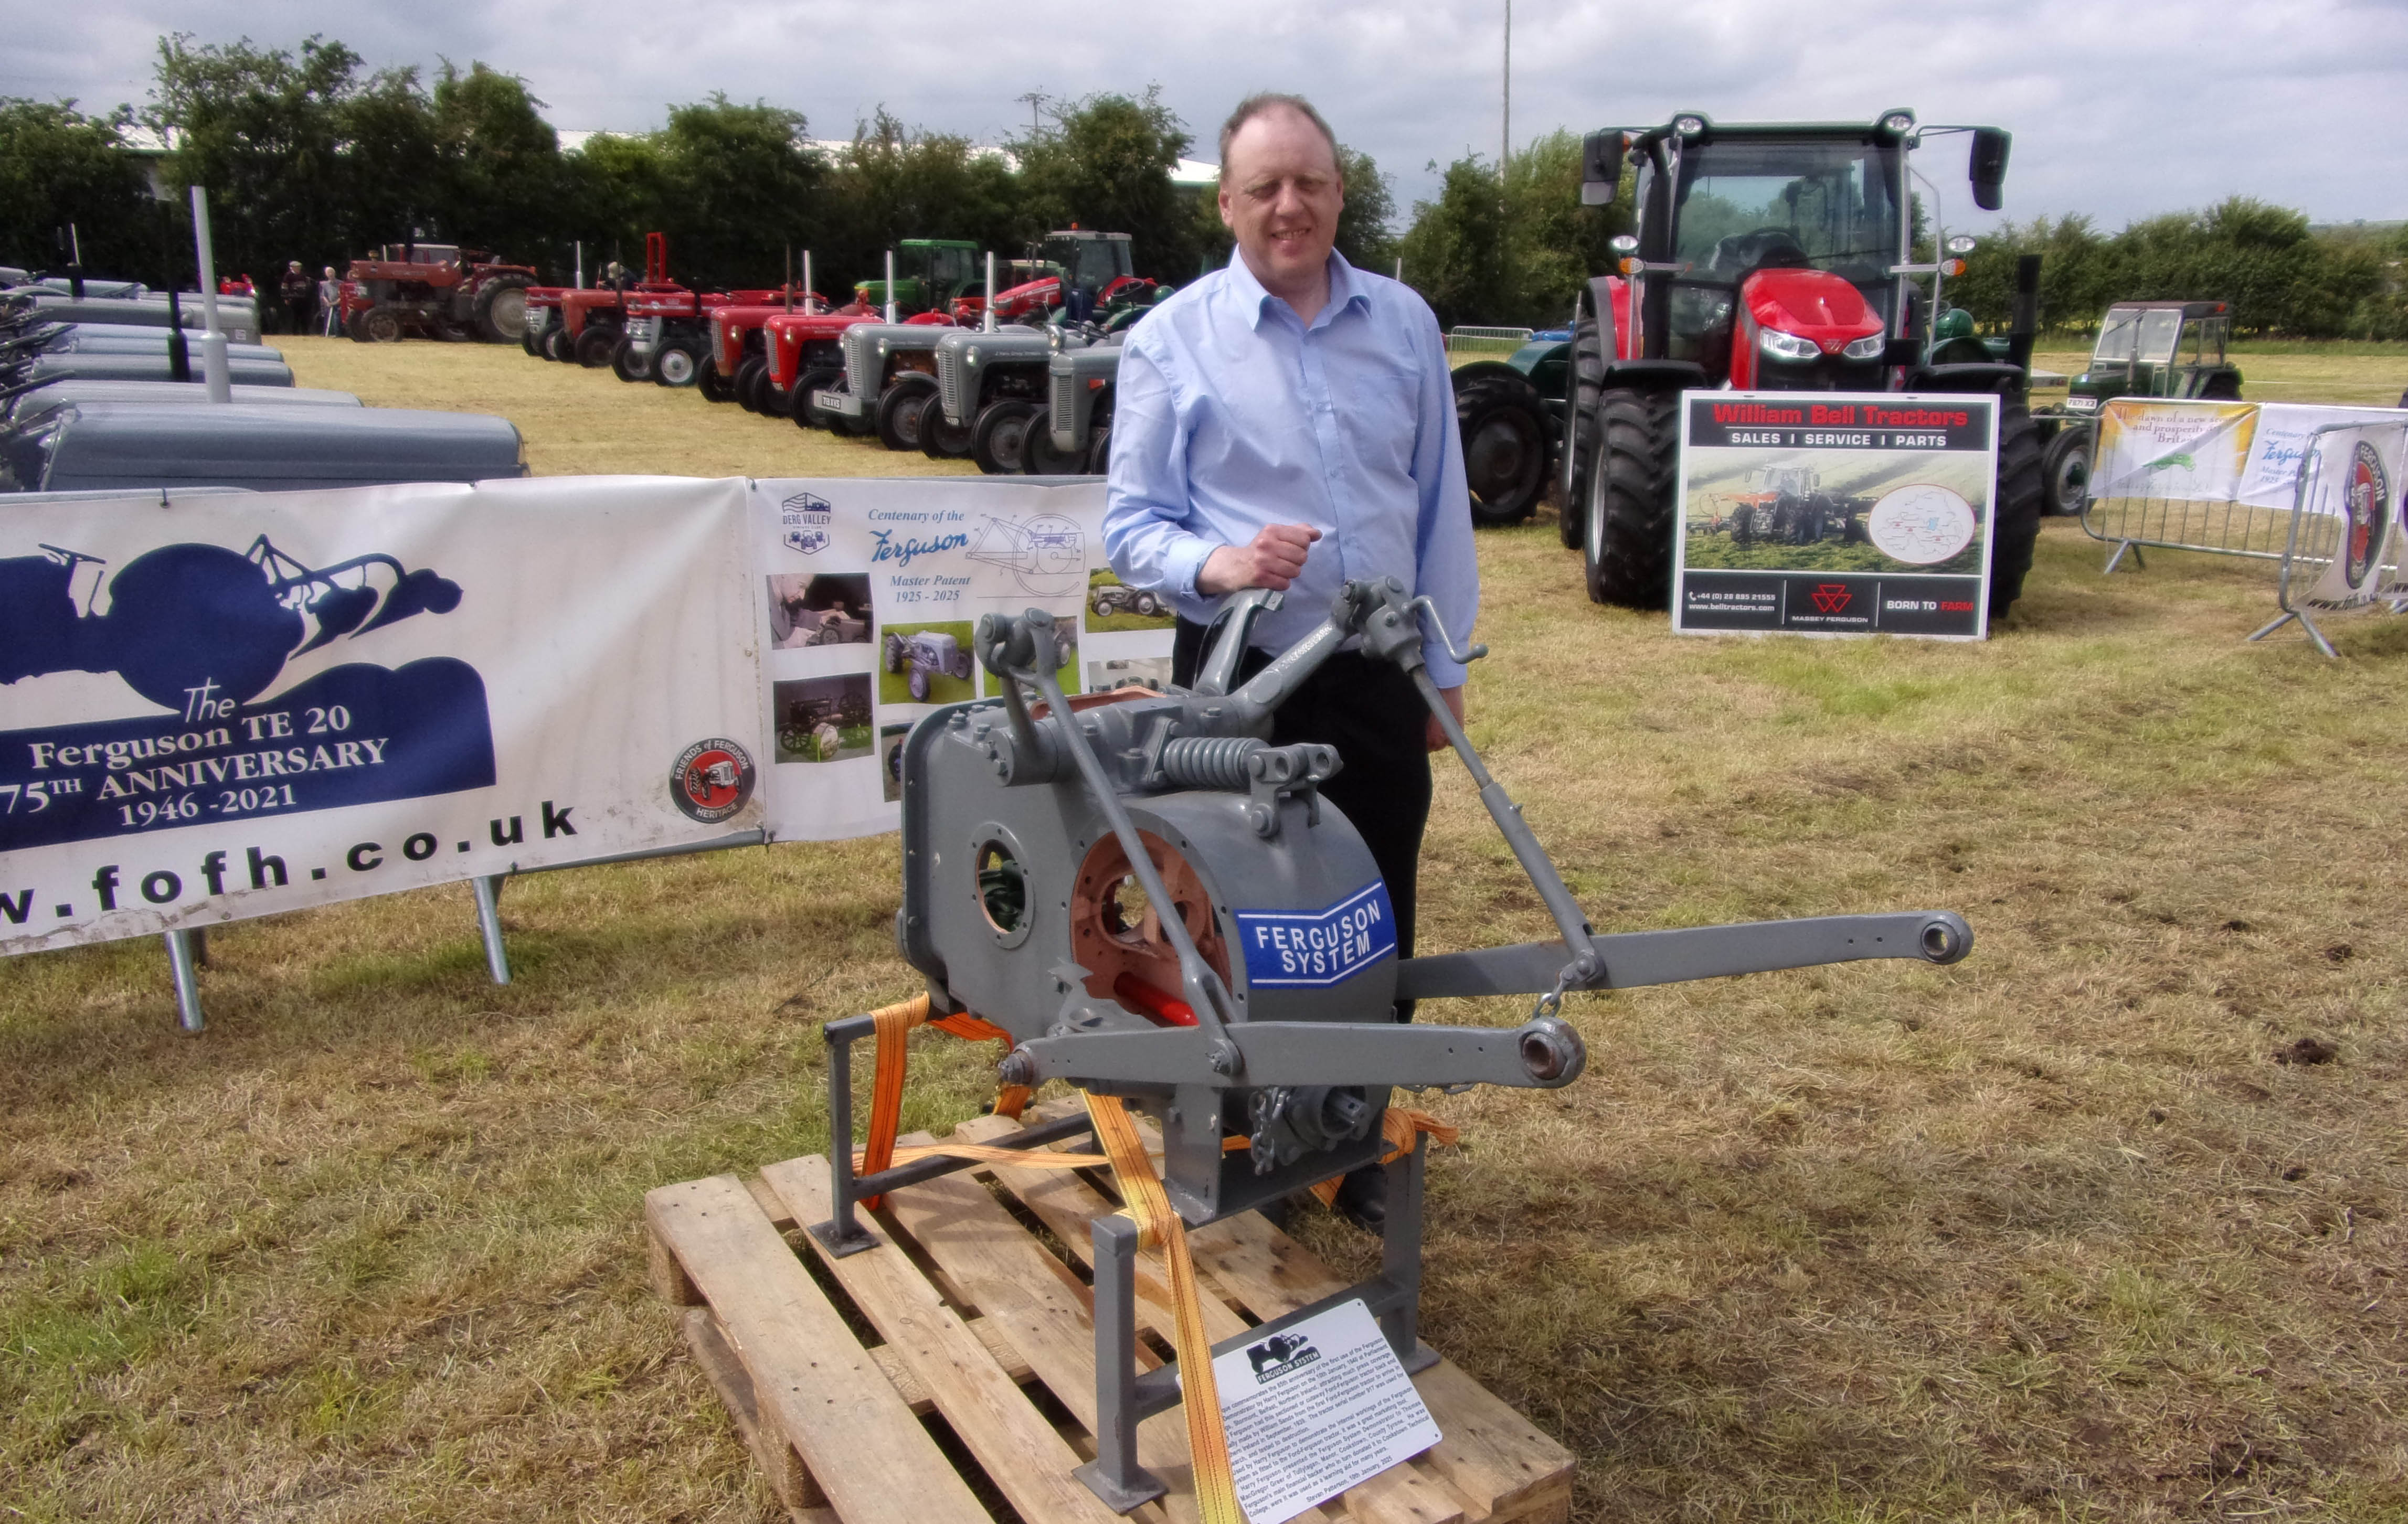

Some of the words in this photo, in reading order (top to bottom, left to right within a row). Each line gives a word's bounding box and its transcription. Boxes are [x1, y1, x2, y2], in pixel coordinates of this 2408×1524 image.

[1713, 403, 1802, 423] William
[1811, 404, 1855, 424] Bell
[1863, 406, 1968, 426] Tractors
[2133, 422, 2152, 431] and
[2138, 409, 2163, 421] dawn
[2167, 411, 2179, 422] of
[1732, 432, 1780, 443] SALES
[1805, 433, 1871, 445] SERVICE
[1896, 435, 1946, 446] PARTS
[783, 514, 801, 525] DERG
[803, 514, 831, 525] VALLEY
[868, 509, 929, 523] Centenary
[932, 510, 946, 524] of
[947, 510, 964, 521] the
[868, 529, 969, 567] Ferguson
[890, 575, 930, 587] Master
[932, 574, 971, 586] Patent
[896, 591, 922, 603] 1925
[932, 590, 960, 601] 2025
[1887, 601, 1919, 610] BORN
[1923, 601, 1937, 610] TO
[1940, 601, 1974, 611] FARM
[184, 677, 236, 723] The
[28, 727, 232, 770] Ferguson
[241, 711, 293, 741] TE
[305, 705, 350, 734] 20
[97, 738, 389, 800] ANNIVERSARY
[675, 744, 702, 780] FRIENDS
[714, 740, 750, 770] FERGUSON
[118, 792, 198, 827] 1946
[696, 803, 738, 819] HERITAGE
[1256, 899, 1381, 950] FERGUSON
[1282, 930, 1371, 974] SYSTEM
[1231, 1389, 1268, 1409] commemorates
[1288, 1368, 1316, 1383] anniversary
[1329, 1355, 1340, 1364] first
[1362, 1337, 1384, 1349] Ferguson
[1257, 1362, 1293, 1383] FERGUSON
[1294, 1351, 1319, 1367] SYSTEM
[1263, 1394, 1278, 1403] Harry
[1277, 1383, 1300, 1397] Ferguson
[1363, 1342, 1388, 1358] Parliament
[1278, 1393, 1300, 1405] Northern
[1319, 1373, 1342, 1387] attracting
[1342, 1366, 1355, 1377] much
[1356, 1361, 1369, 1371] press
[1240, 1480, 1256, 1490] Harry
[1256, 1468, 1281, 1483] Ferguson
[1282, 1454, 1308, 1472] presented
[1318, 1439, 1342, 1453] Ferguson
[1343, 1430, 1361, 1441] System
[1362, 1414, 1395, 1432] Demonstrator
[1403, 1401, 1421, 1413] Thomas
[1253, 1455, 1268, 1465] Harry
[1267, 1444, 1291, 1458] Ferguson
[1297, 1427, 1328, 1444] demonstrate
[1336, 1413, 1355, 1425] internal
[1355, 1404, 1376, 1416] workings
[1391, 1387, 1413, 1400] Ferguson
[1240, 1484, 1269, 1501] MacGregor
[1368, 1427, 1386, 1439] County
[1244, 1493, 1272, 1509] Ferguson's
[1272, 1486, 1286, 1495] main
[1285, 1474, 1307, 1489] financial
[1307, 1467, 1324, 1478] backer
[1324, 1462, 1335, 1470] who
[1352, 1443, 1372, 1456] donated
[1382, 1426, 1408, 1441] Cookstown
[1408, 1414, 1429, 1428] Technical
[1299, 1482, 1311, 1493] used
[1323, 1468, 1344, 1480] learning
[1343, 1462, 1352, 1470] aid
[1360, 1453, 1374, 1462] many
[1306, 1491, 1323, 1502] Stevan
[1381, 1455, 1392, 1465] 2025
